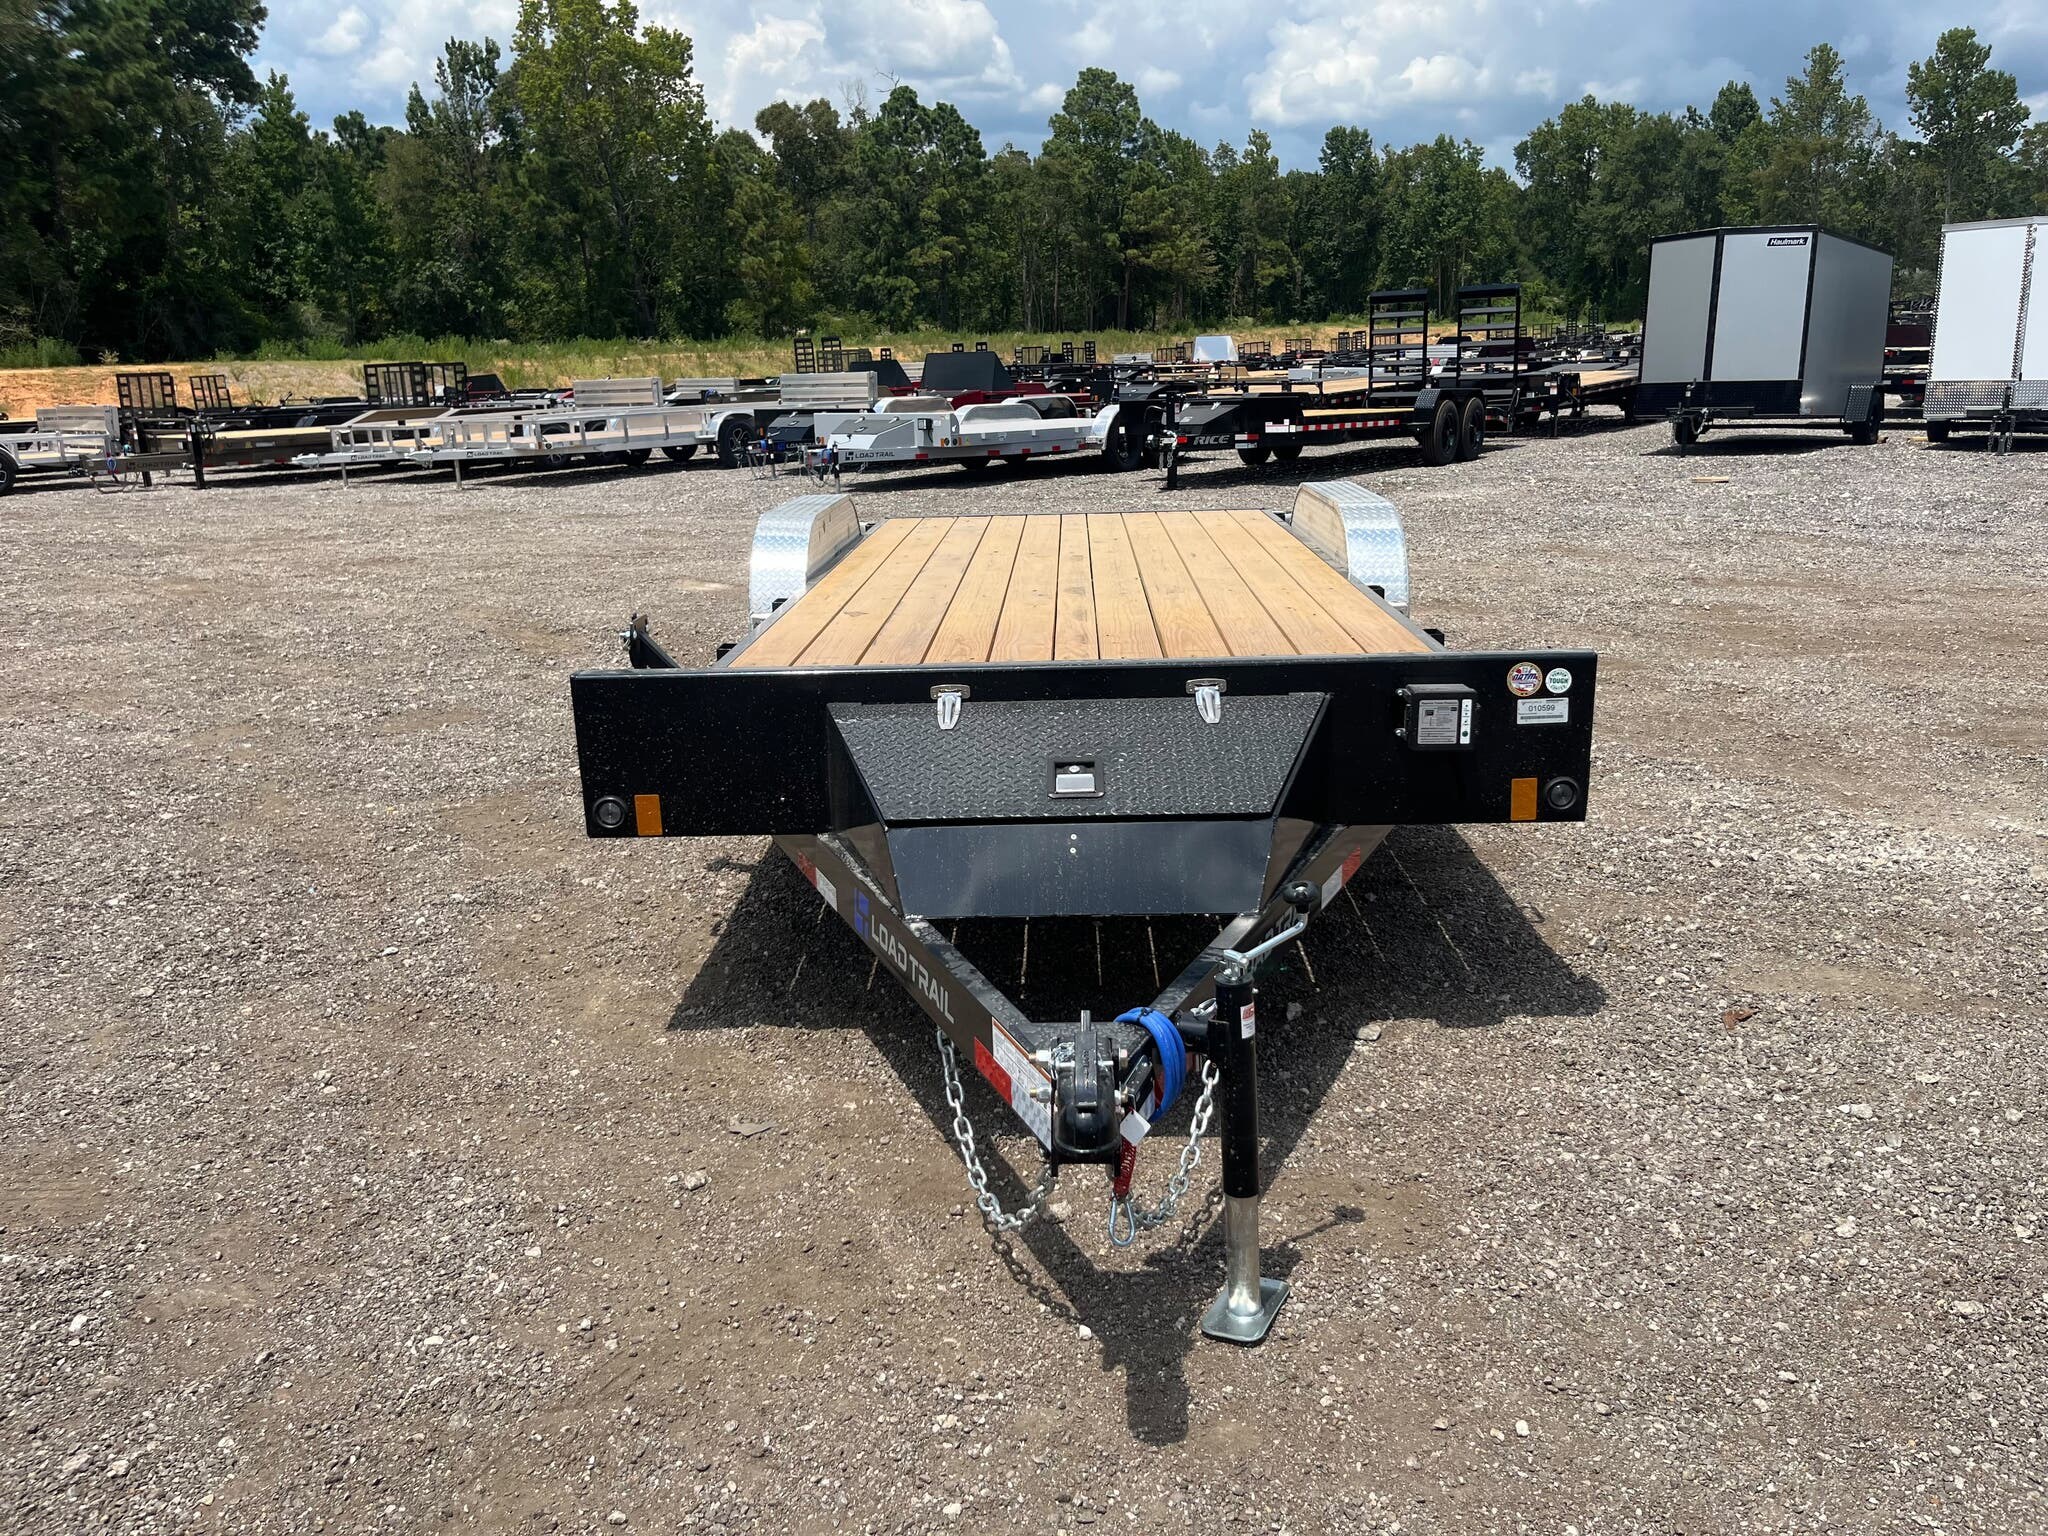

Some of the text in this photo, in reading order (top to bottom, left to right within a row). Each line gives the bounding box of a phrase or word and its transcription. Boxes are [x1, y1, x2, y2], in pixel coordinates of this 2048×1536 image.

[1770, 238, 1806, 246] Haulmark
[1193, 434, 1230, 445] RICE
[1528, 704, 1556, 712] 010599
[871, 914, 955, 1024] LOAD TRAIL
